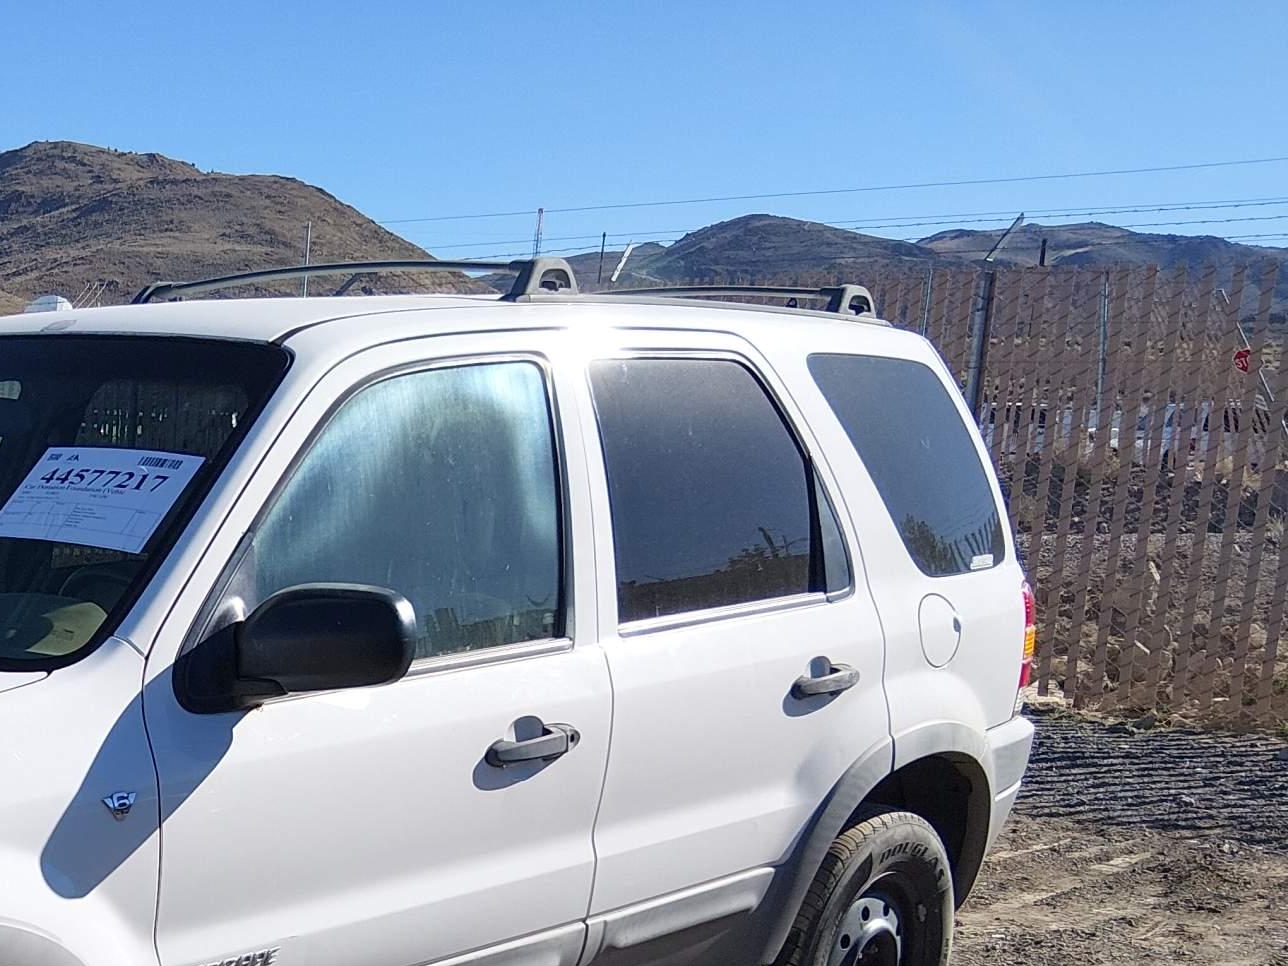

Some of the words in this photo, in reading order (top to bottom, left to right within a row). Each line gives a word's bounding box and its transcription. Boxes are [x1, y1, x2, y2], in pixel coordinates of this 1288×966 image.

[1234, 357, 1249, 368] ST
[41, 467, 169, 492] 44577217
[102, 791, 136, 815] V6
